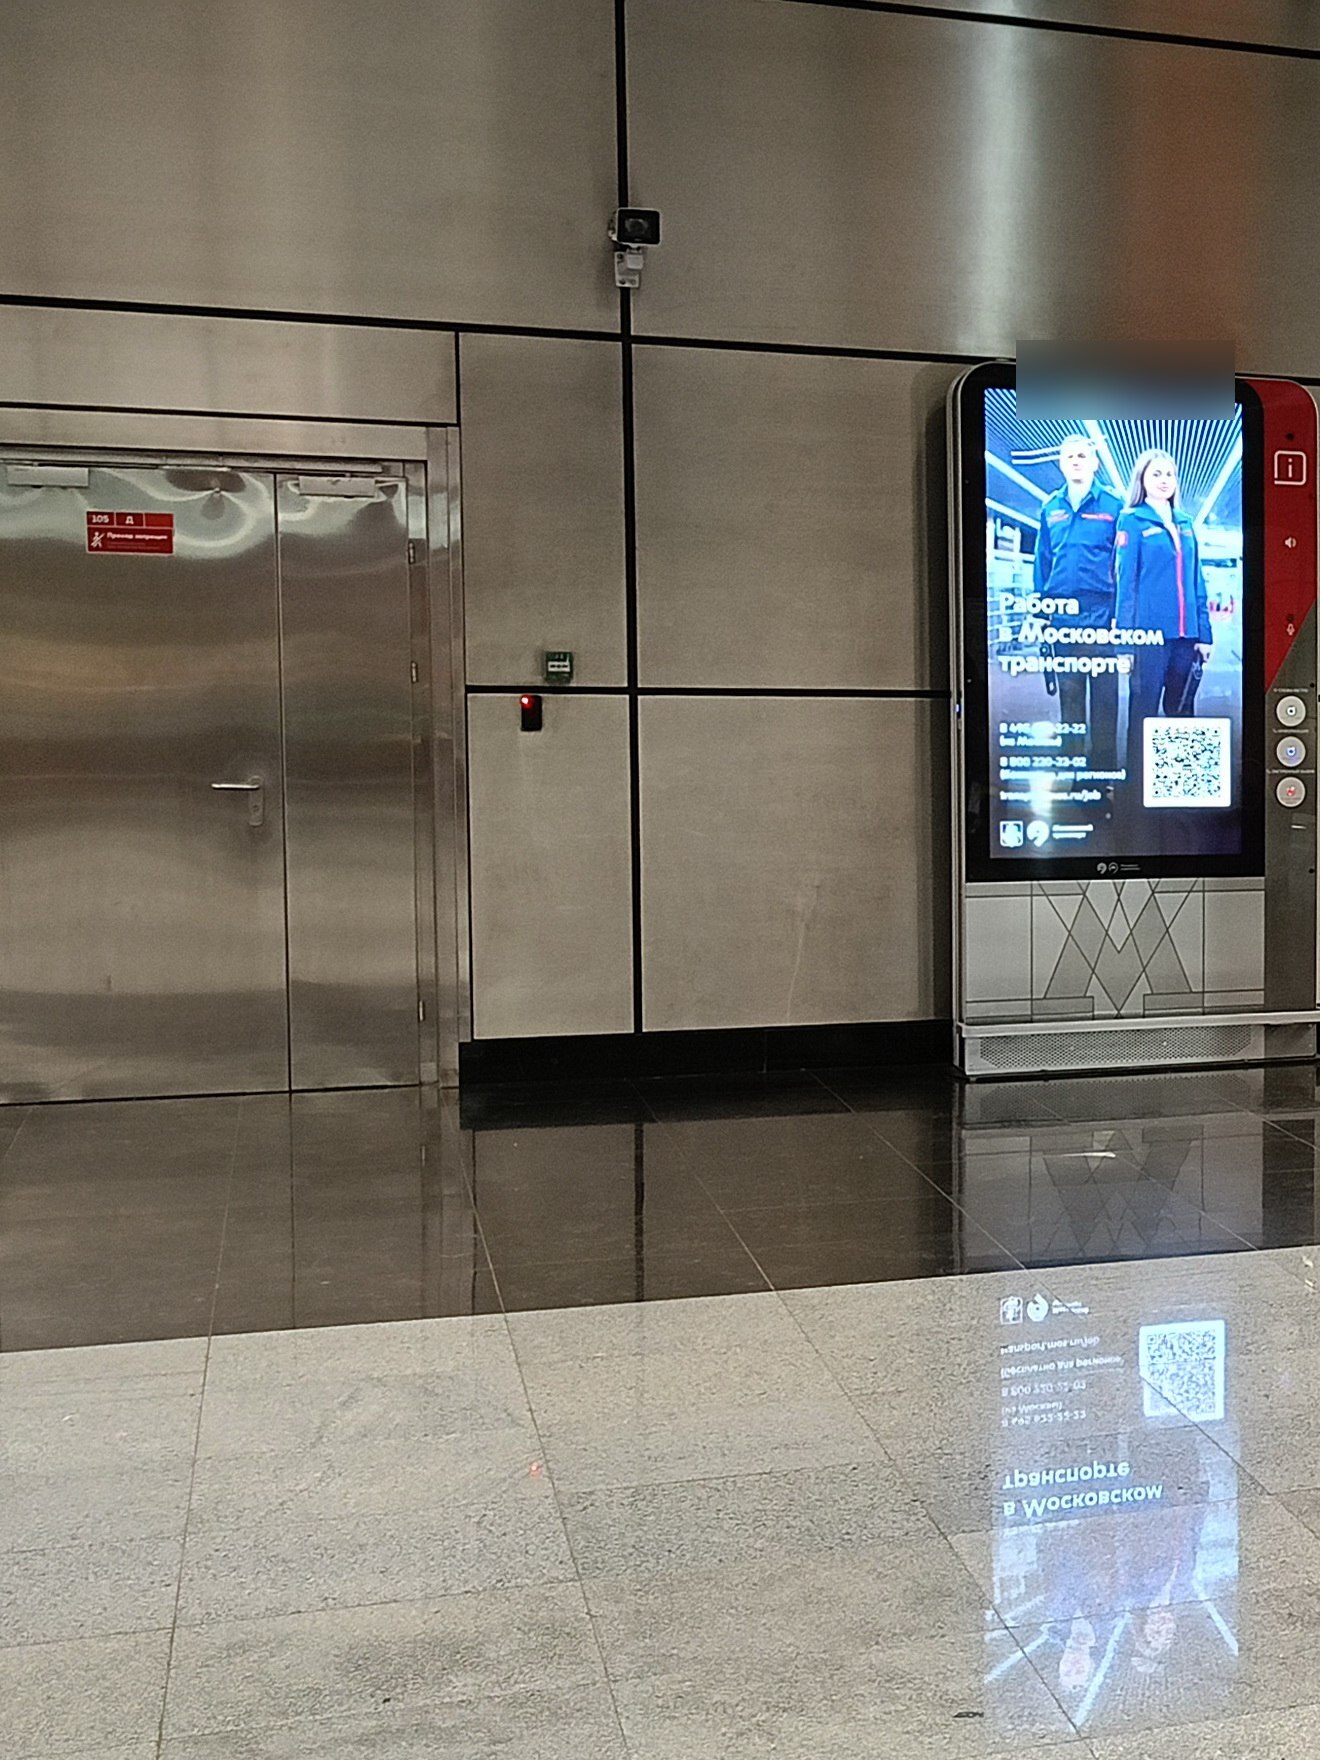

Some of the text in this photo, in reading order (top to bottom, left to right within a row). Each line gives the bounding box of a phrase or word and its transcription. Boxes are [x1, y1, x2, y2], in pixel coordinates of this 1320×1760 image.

[92, 514, 110, 523] 105
[125, 515, 134, 525] Д
[1000, 591, 1080, 616] Работа
[1000, 621, 1165, 646] в Московском
[999, 654, 1131, 678] транспорте
